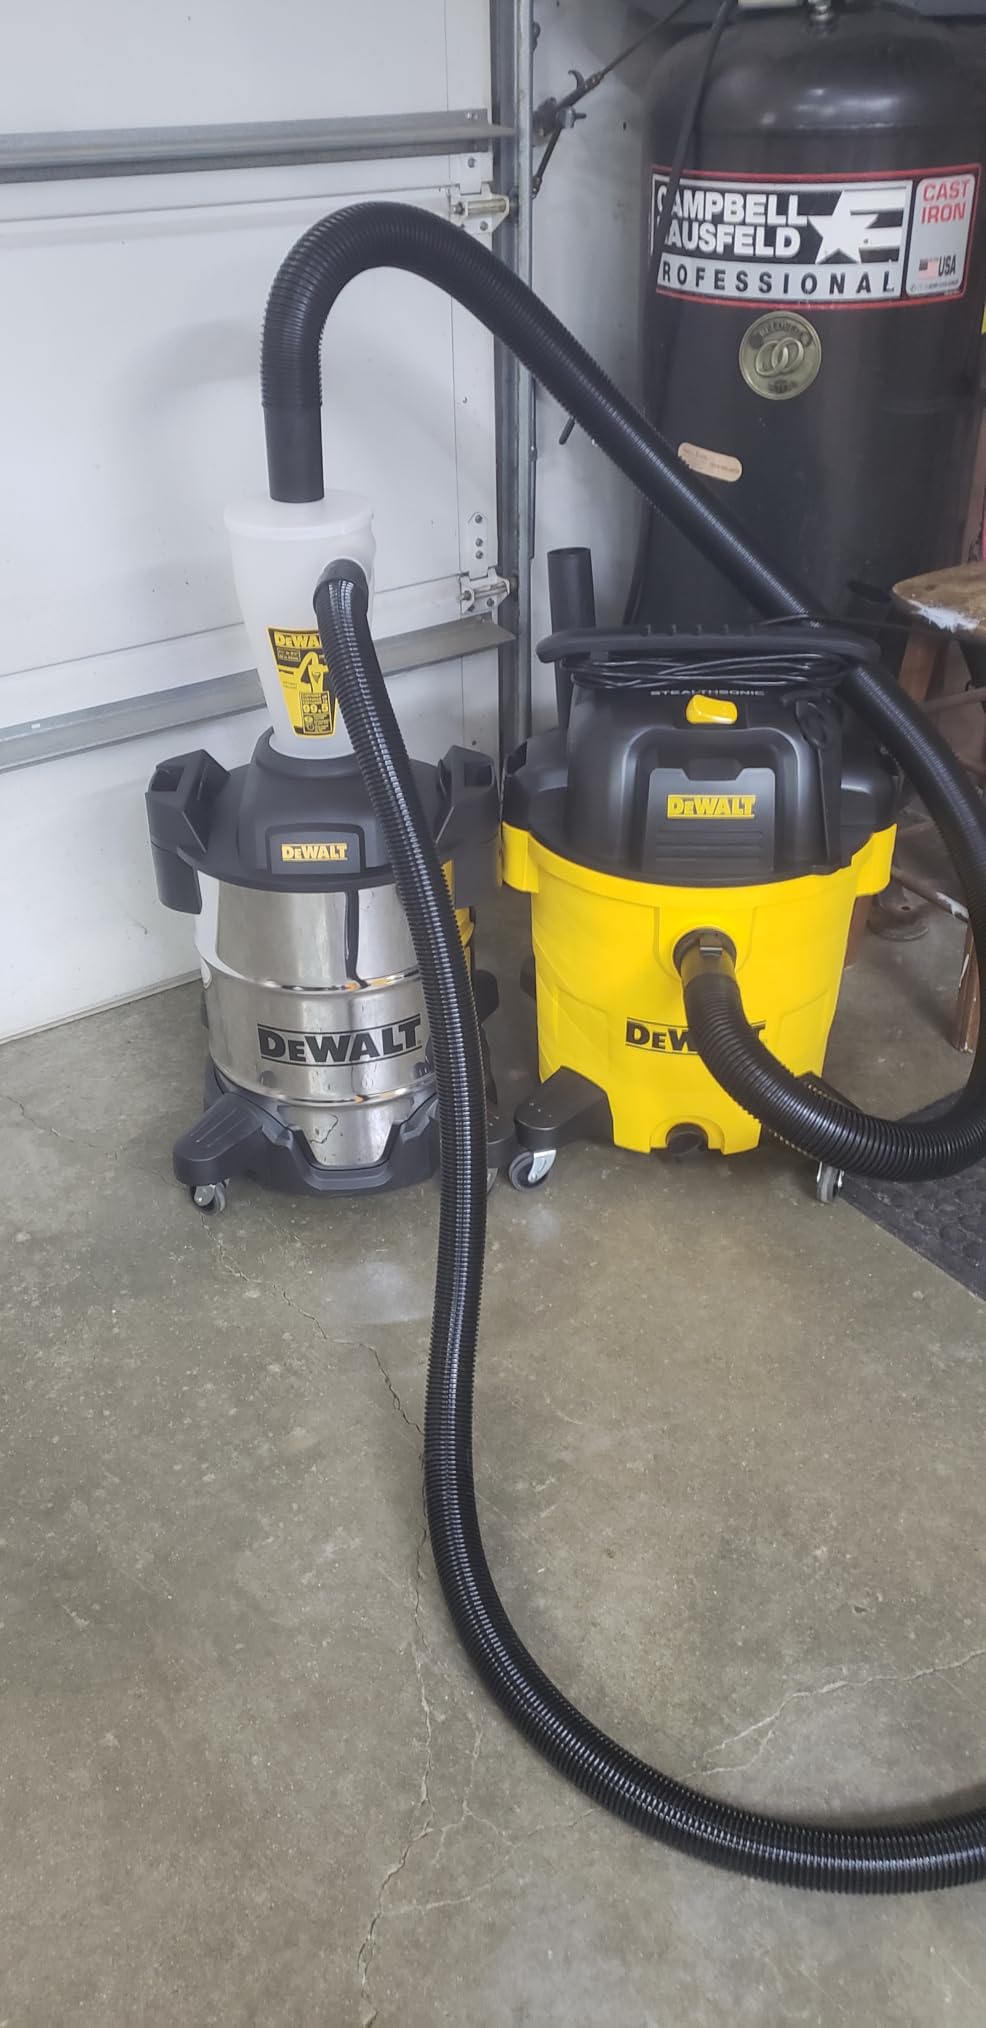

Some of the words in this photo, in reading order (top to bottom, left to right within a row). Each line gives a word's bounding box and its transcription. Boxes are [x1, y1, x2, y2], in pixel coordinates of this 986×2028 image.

[923, 178, 970, 201] CAST
[921, 202, 966, 224] IRON
[658, 218, 801, 258] AUSFELD
[938, 254, 957, 277] USA
[662, 261, 895, 295] ROFESSIONAL
[275, 632, 321, 648] DEWA
